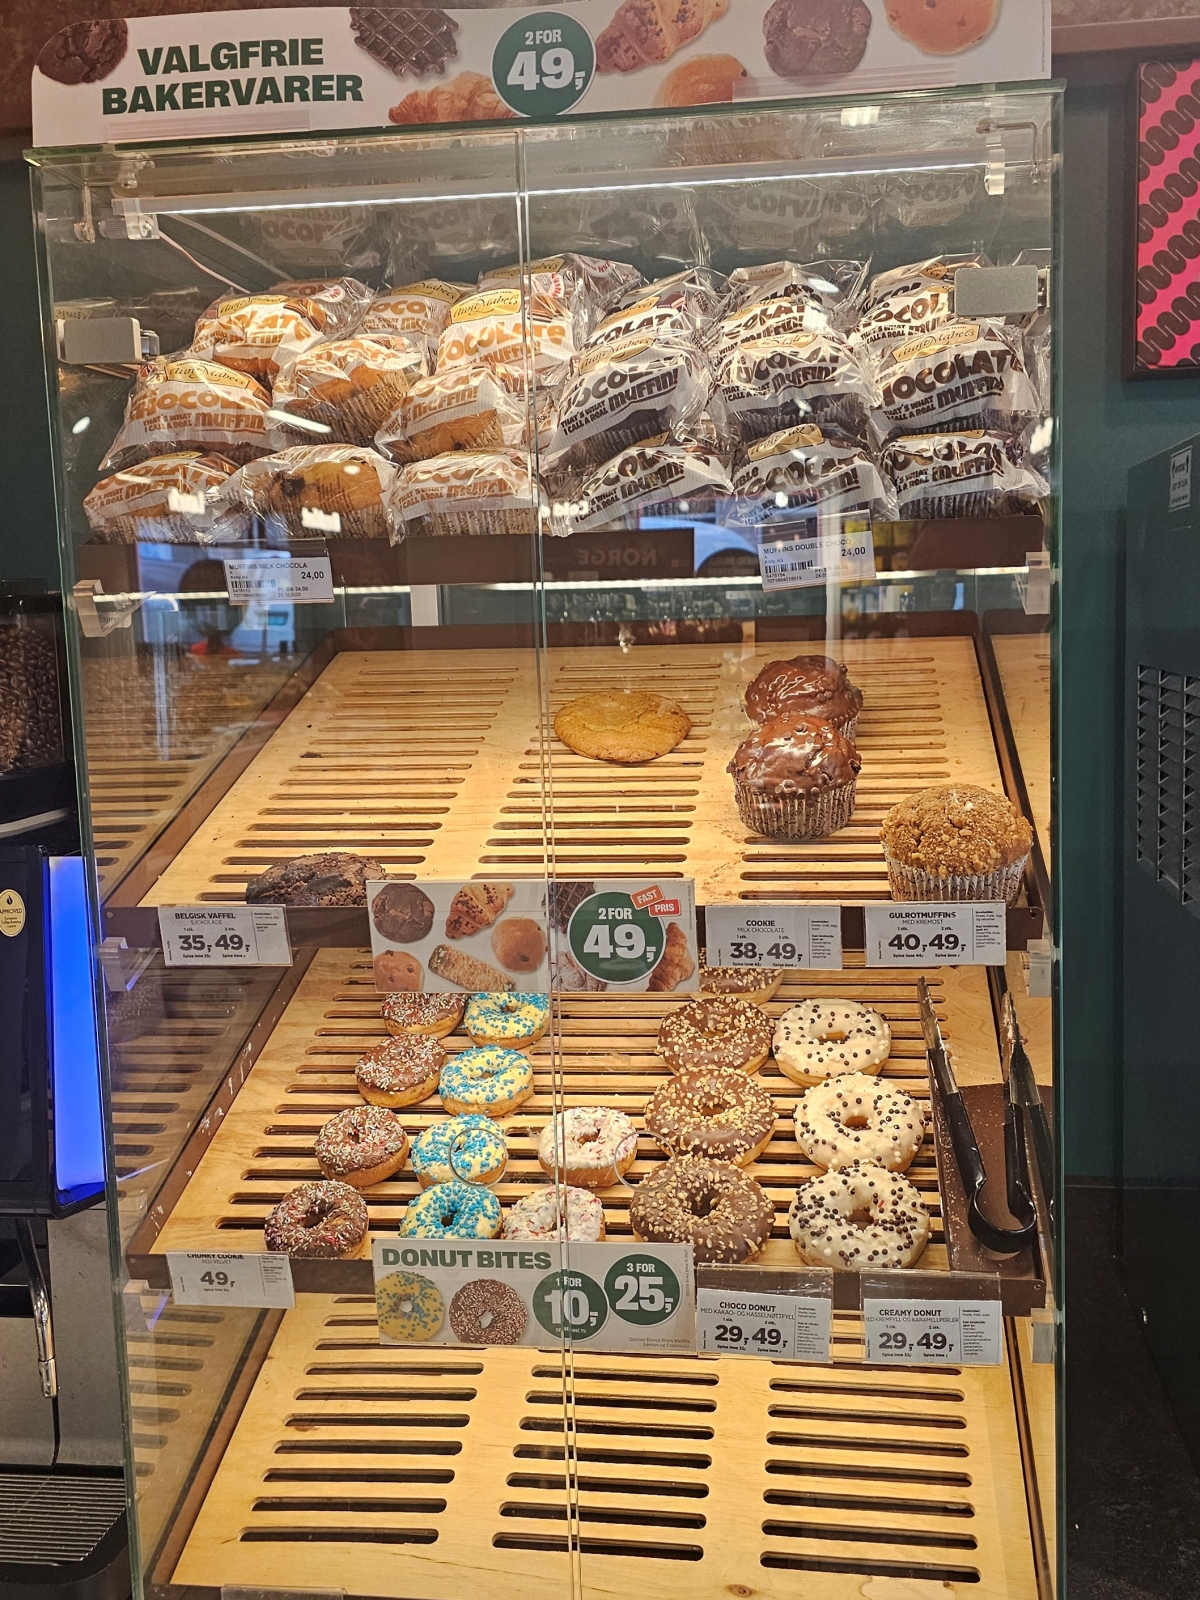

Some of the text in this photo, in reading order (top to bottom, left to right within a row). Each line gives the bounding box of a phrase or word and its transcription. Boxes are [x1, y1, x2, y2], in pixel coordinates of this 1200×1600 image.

[525, 28, 563, 46] 2 FOR
[137, 37, 324, 77] VALGFRIE
[101, 73, 364, 116] BAKERVARER
[728, 392, 746, 401] CALL
[910, 396, 934, 410] WHAT
[143, 413, 192, 427] THAT'S WHAT
[561, 411, 584, 428] THAT'S
[584, 401, 606, 417] WHAT
[147, 424, 166, 433] CALL
[568, 422, 584, 434] CALL
[103, 487, 123, 499] WHAT
[421, 486, 445, 495] WHAT
[596, 487, 617, 501] WHAT
[763, 538, 852, 554] MUFFINS DOUBLE CHOCO
[841, 546, 866, 558] 24,00
[301, 571, 325, 581] 24,00
[636, 889, 658, 905] FAST
[598, 907, 633, 920] 2 FOR
[654, 903, 676, 913] PRIS
[175, 912, 206, 920] BELGISK
[381, 1247, 552, 1270] DONUT BITES
[627, 1263, 656, 1273] 3 FOR
[719, 1301, 776, 1312] CHOCO DONUT
[914, 1309, 942, 1317] DONUT
